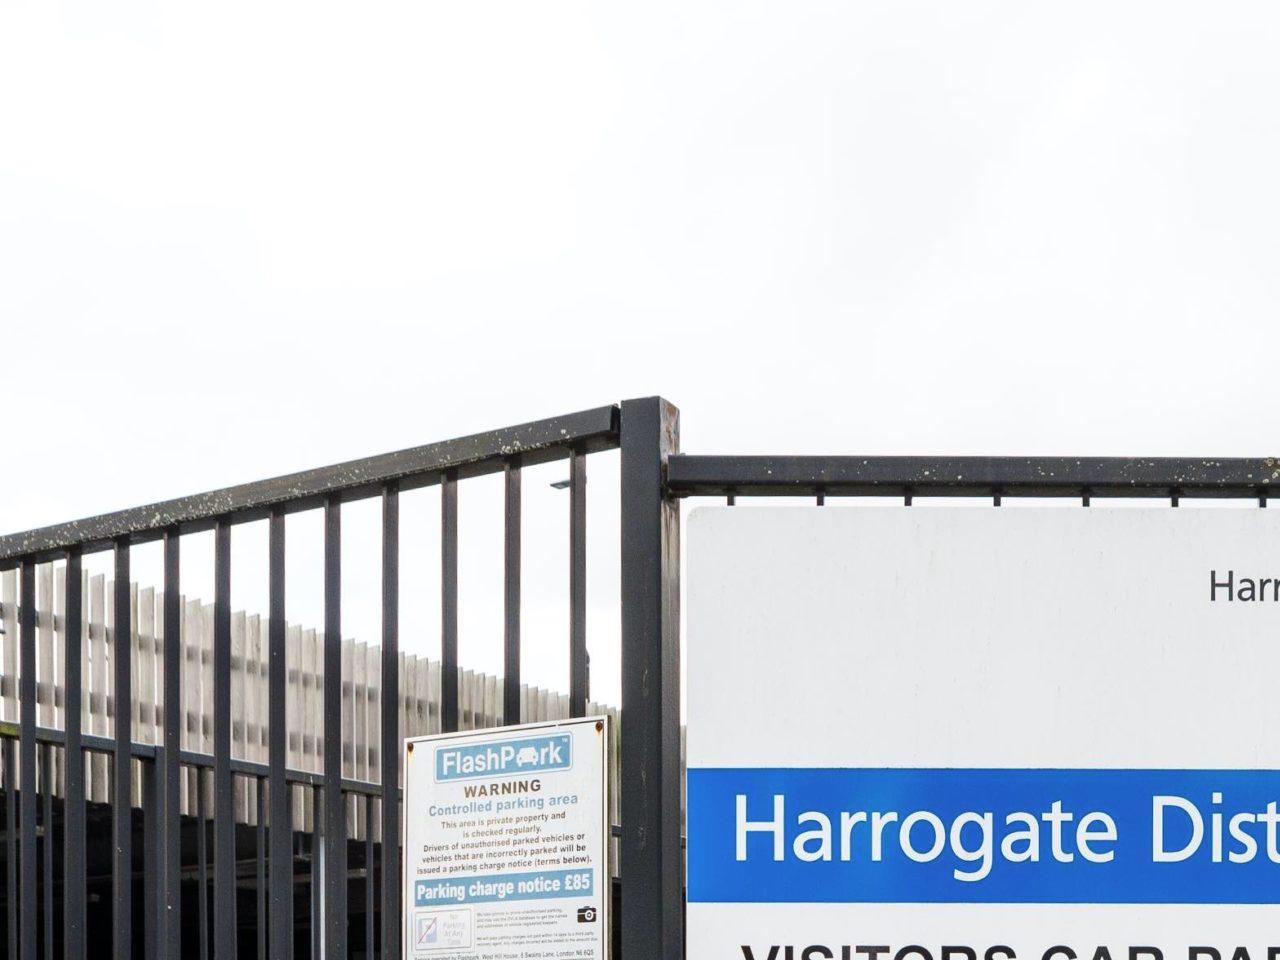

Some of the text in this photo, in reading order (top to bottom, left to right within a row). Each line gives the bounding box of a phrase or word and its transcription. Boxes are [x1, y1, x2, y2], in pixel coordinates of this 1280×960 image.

[464, 779, 541, 798] WARNING
[429, 795, 578, 817] Controlled parking area
[441, 812, 566, 830] This area is private property and
[463, 825, 542, 838] is checked regularly.
[735, 794, 1118, 882] Harrogate
[423, 843, 449, 852] Drivers
[461, 839, 510, 850] unauthorised
[512, 837, 540, 847] parked
[542, 833, 574, 843] vehicles
[422, 844, 586, 864] vehicles that are incorrectly parked will be
[417, 866, 440, 875] issued
[449, 863, 477, 873] parking
[479, 862, 505, 872] charge
[507, 859, 532, 868] notice
[534, 857, 561, 867] (terms
[563, 855, 592, 865] below).
[417, 873, 590, 901] Parking charge notice £85
